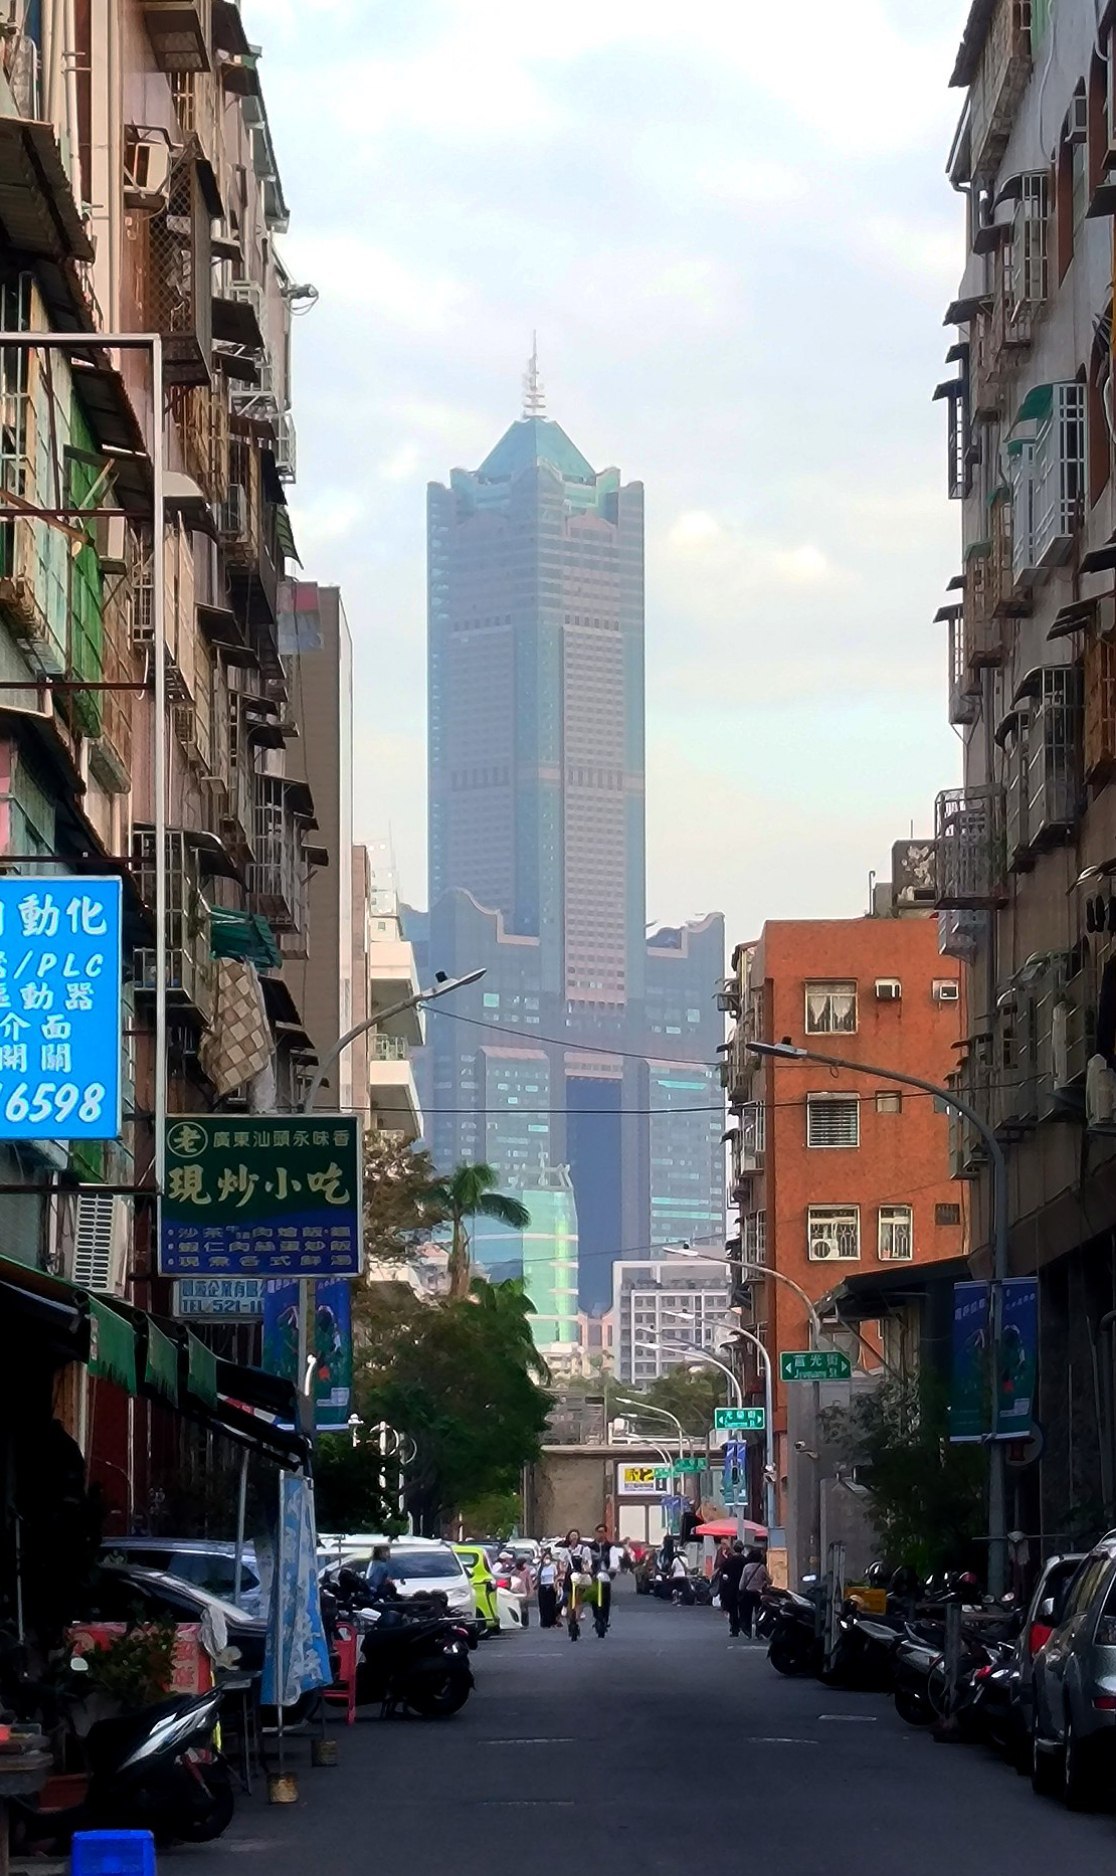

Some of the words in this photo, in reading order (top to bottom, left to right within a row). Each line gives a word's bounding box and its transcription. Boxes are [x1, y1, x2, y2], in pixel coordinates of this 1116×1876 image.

[0, 893, 107, 937] 動化
[0, 950, 103, 980] /PLC
[0, 1012, 72, 1041] 介面
[0, 1082, 106, 1123] 6598
[174, 1125, 202, 1154] 老
[213, 1129, 350, 1148] 廣東汕頭永味香
[168, 1161, 350, 1208] 現炒小吃
[182, 1300, 205, 1315] TEL
